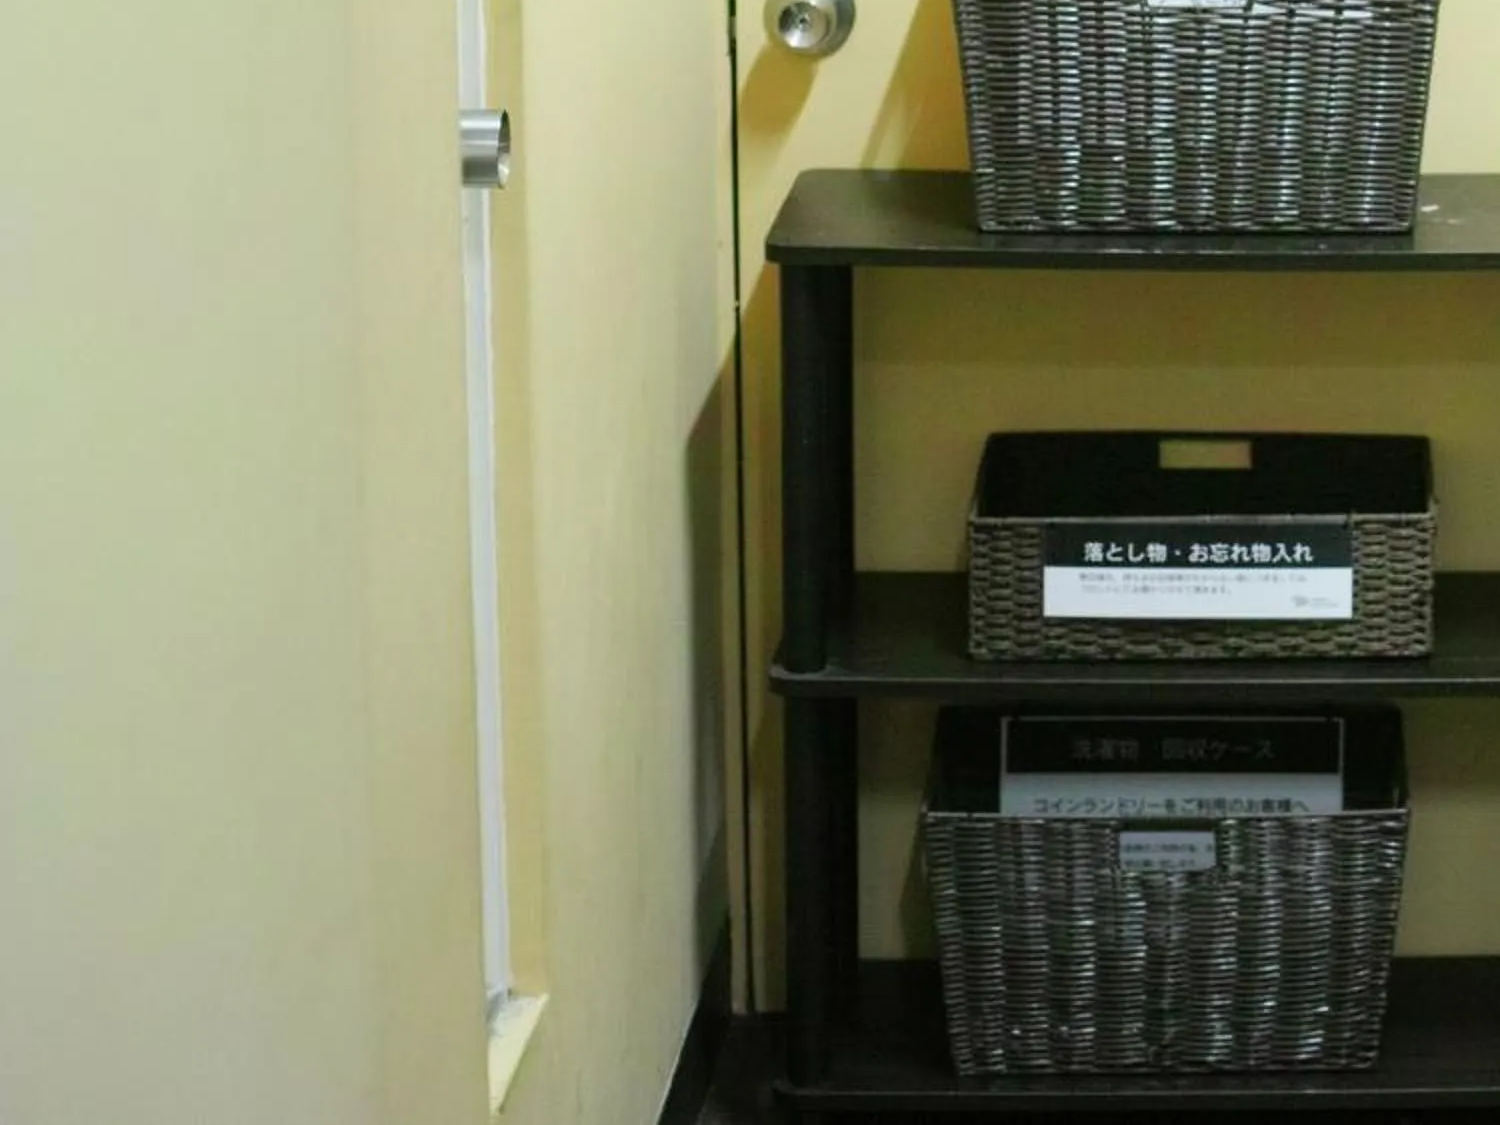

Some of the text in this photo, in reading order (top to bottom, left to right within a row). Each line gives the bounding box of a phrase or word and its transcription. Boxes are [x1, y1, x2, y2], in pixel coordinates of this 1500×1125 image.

[1083, 542, 1314, 563] 落とし物・お忘れ物入れ
